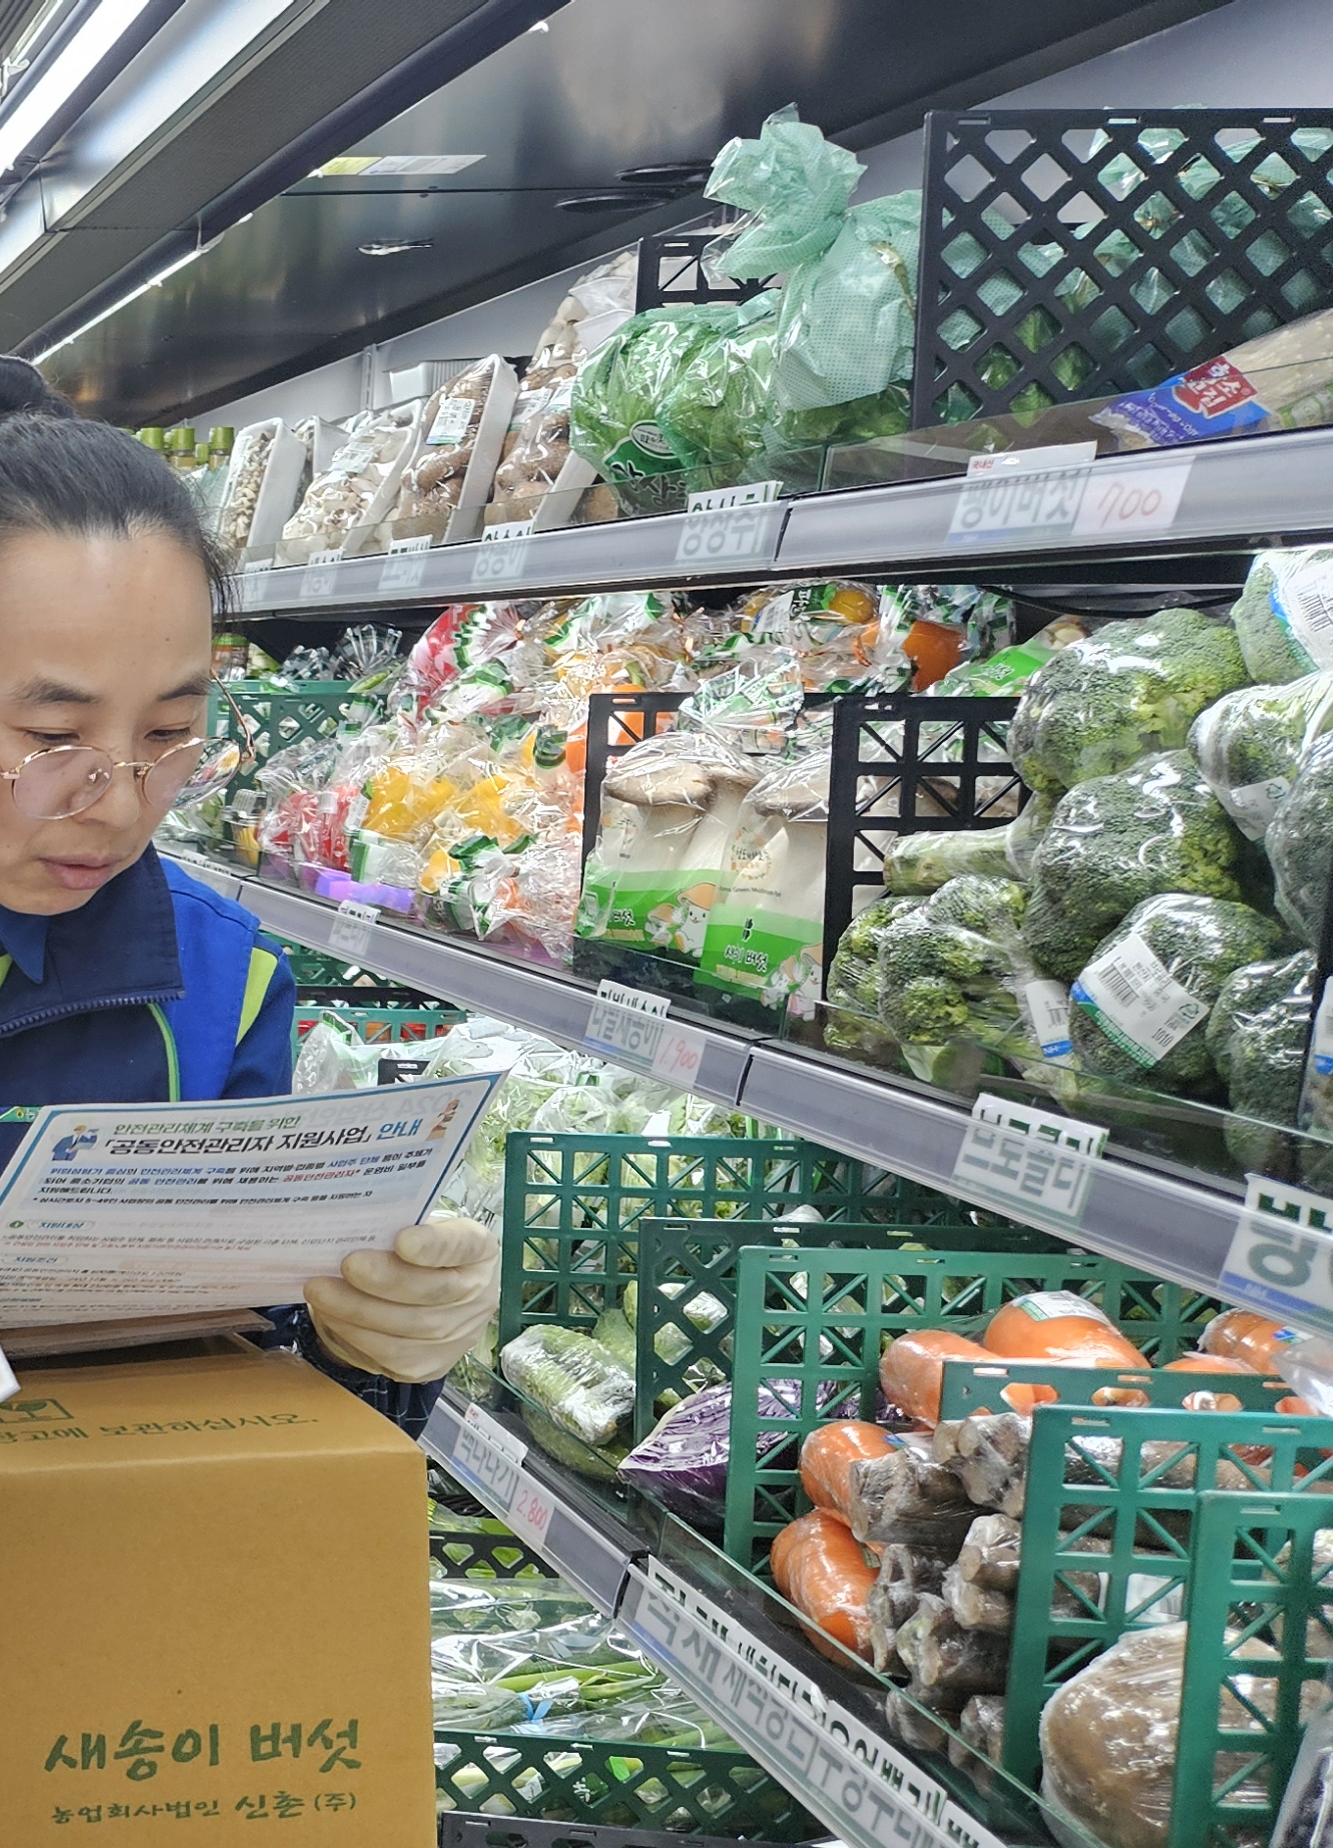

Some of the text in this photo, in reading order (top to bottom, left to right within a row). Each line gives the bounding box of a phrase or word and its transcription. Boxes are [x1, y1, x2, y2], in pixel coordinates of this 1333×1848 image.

[106, 1118, 424, 1155] 「공동안전관리자 지원사업」 안내
[114, 1115, 302, 1136] 안전관리체계 구축을 위한
[98, 1412, 321, 1438] 보관하십시오.
[43, 1718, 362, 1782] 새송이 버섯
[51, 1791, 357, 1824] 농업회사법인 신촌 (주)
